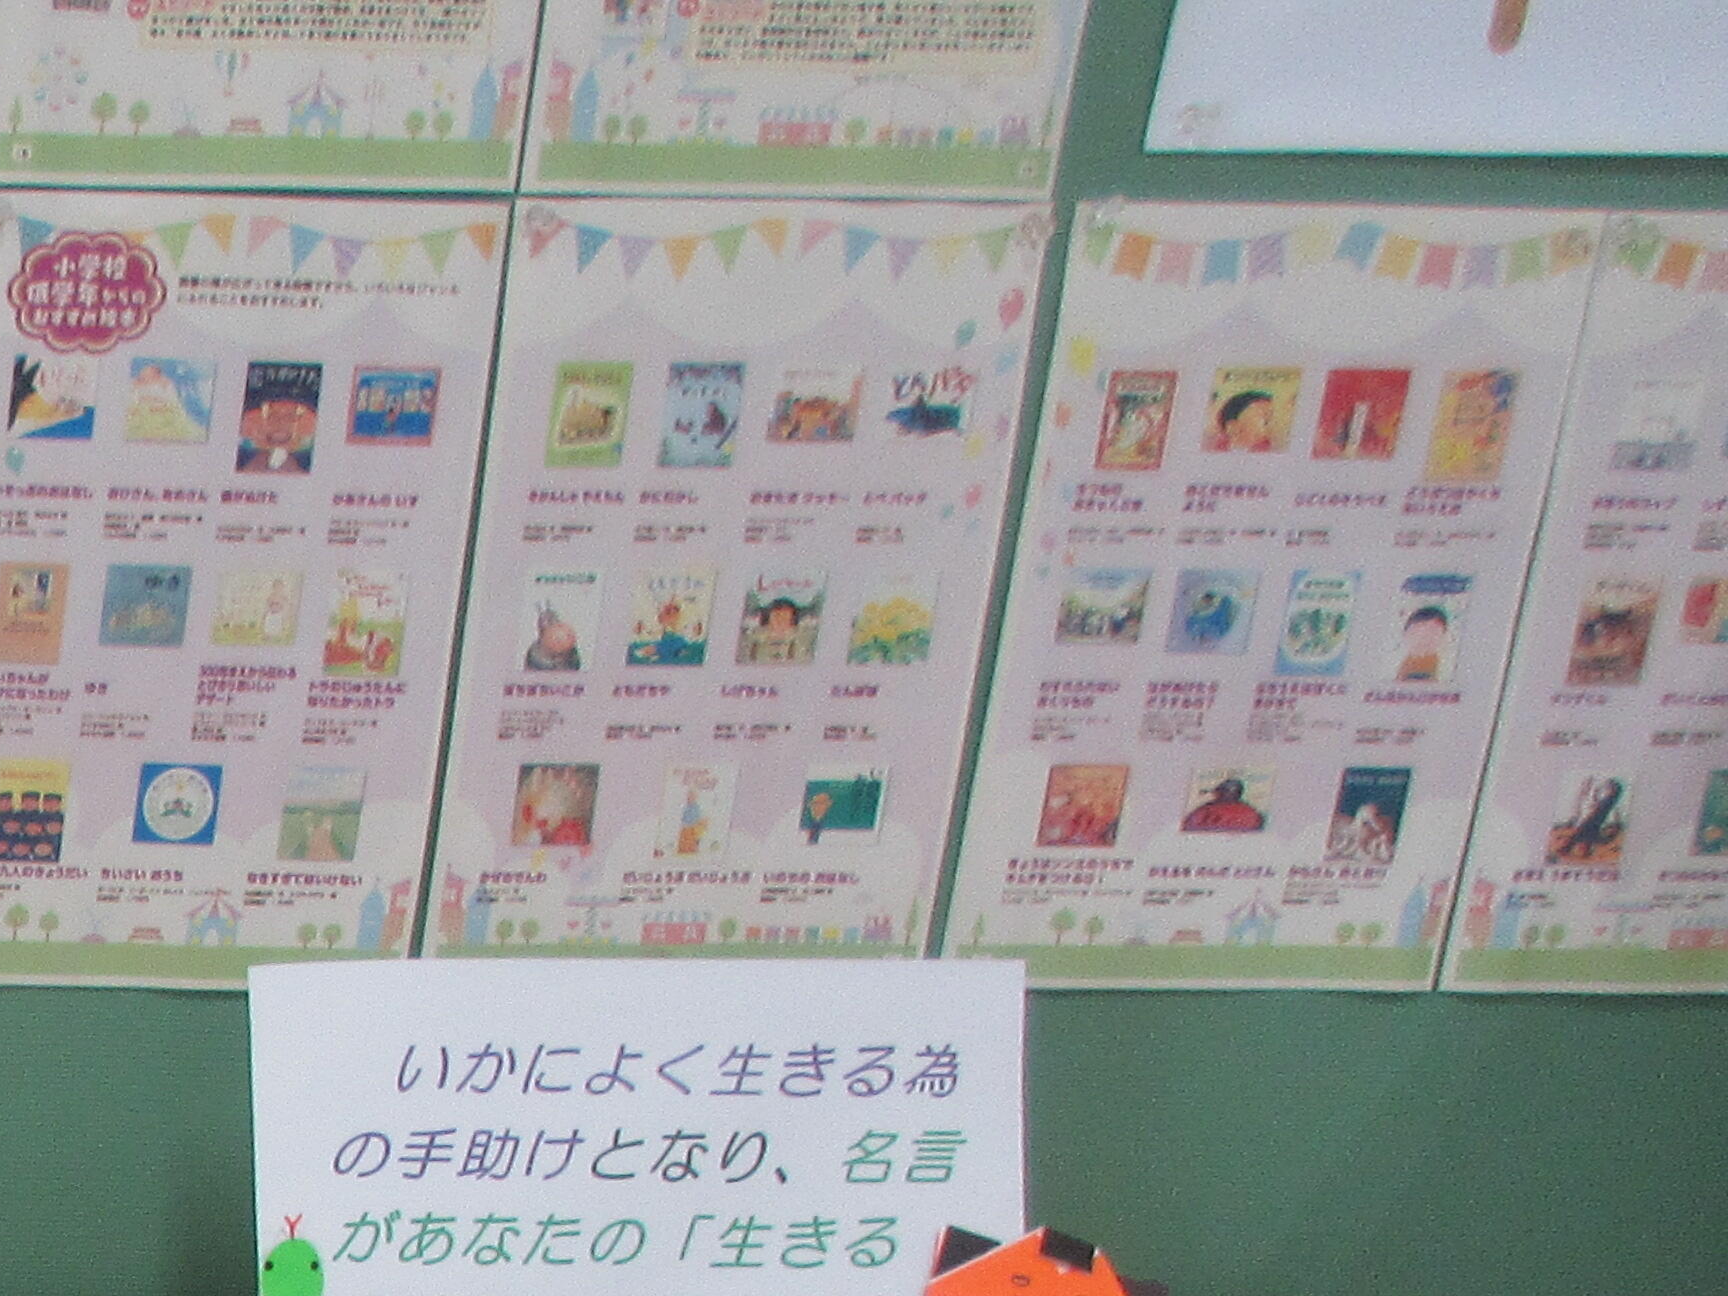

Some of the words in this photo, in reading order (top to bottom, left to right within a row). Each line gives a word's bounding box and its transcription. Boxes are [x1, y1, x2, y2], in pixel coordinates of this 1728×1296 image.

[396, 1042, 962, 1101] いかによく生きる為
[331, 1127, 968, 1187] の手助けとなり、名言
[331, 1210, 901, 1269] があなたの「生きる
